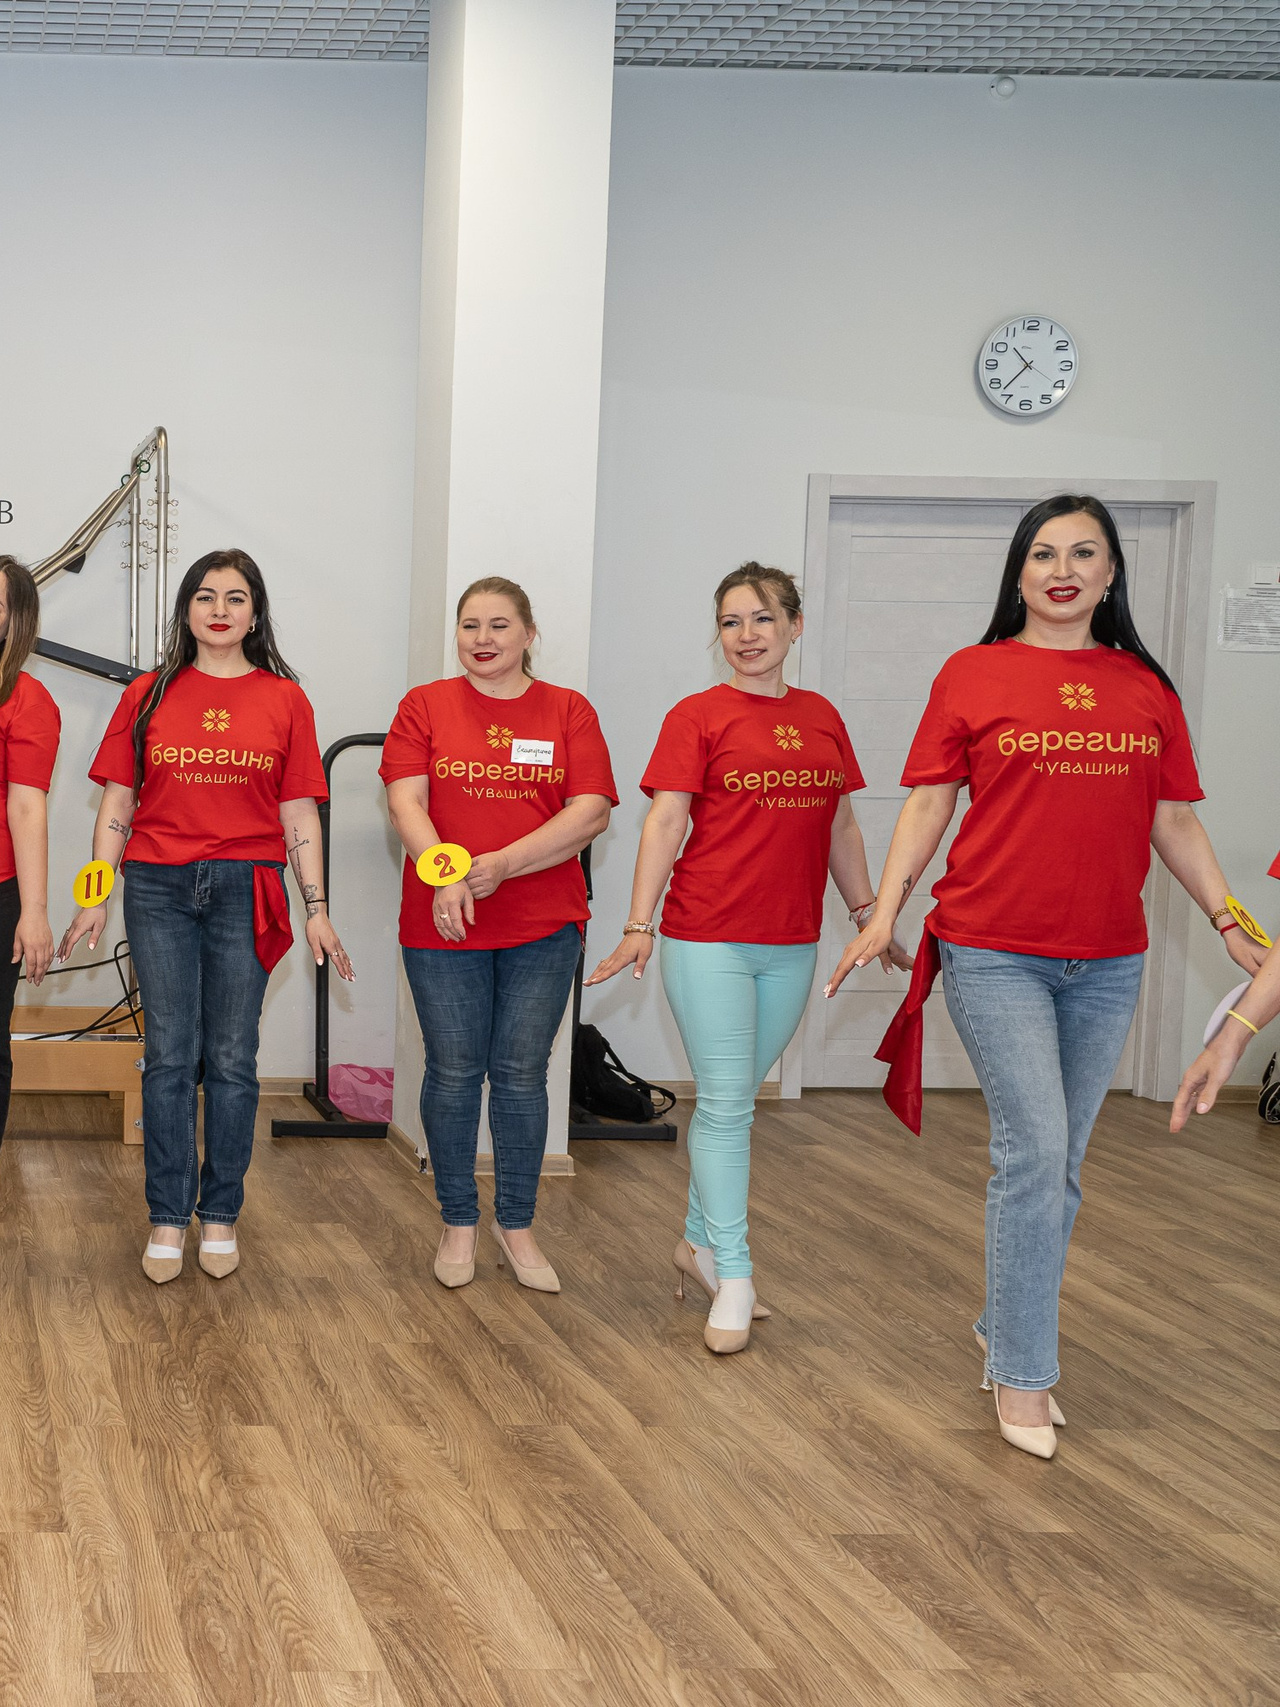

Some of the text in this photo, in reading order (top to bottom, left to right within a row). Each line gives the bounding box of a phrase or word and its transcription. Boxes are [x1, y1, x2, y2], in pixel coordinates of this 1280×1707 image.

[1022, 320, 1040, 331] 12
[1005, 327, 1016, 337] 11
[990, 342, 1008, 353] 10
[1055, 340, 1069, 351] 2
[985, 359, 998, 370] 9
[1059, 360, 1073, 371] 3
[989, 378, 1002, 389] 8
[1053, 379, 1066, 391] 4
[1001, 394, 1014, 405] 7
[1019, 399, 1033, 411] 6
[1039, 394, 1052, 405] 5
[997, 729, 1159, 757] берегиня
[151, 743, 274, 773] берегиня
[435, 756, 565, 784] берегиня
[1032, 761, 1129, 776] чувашии
[172, 772, 248, 785] чувашии
[433, 852, 457, 879] 2
[84, 869, 103, 900] 11
